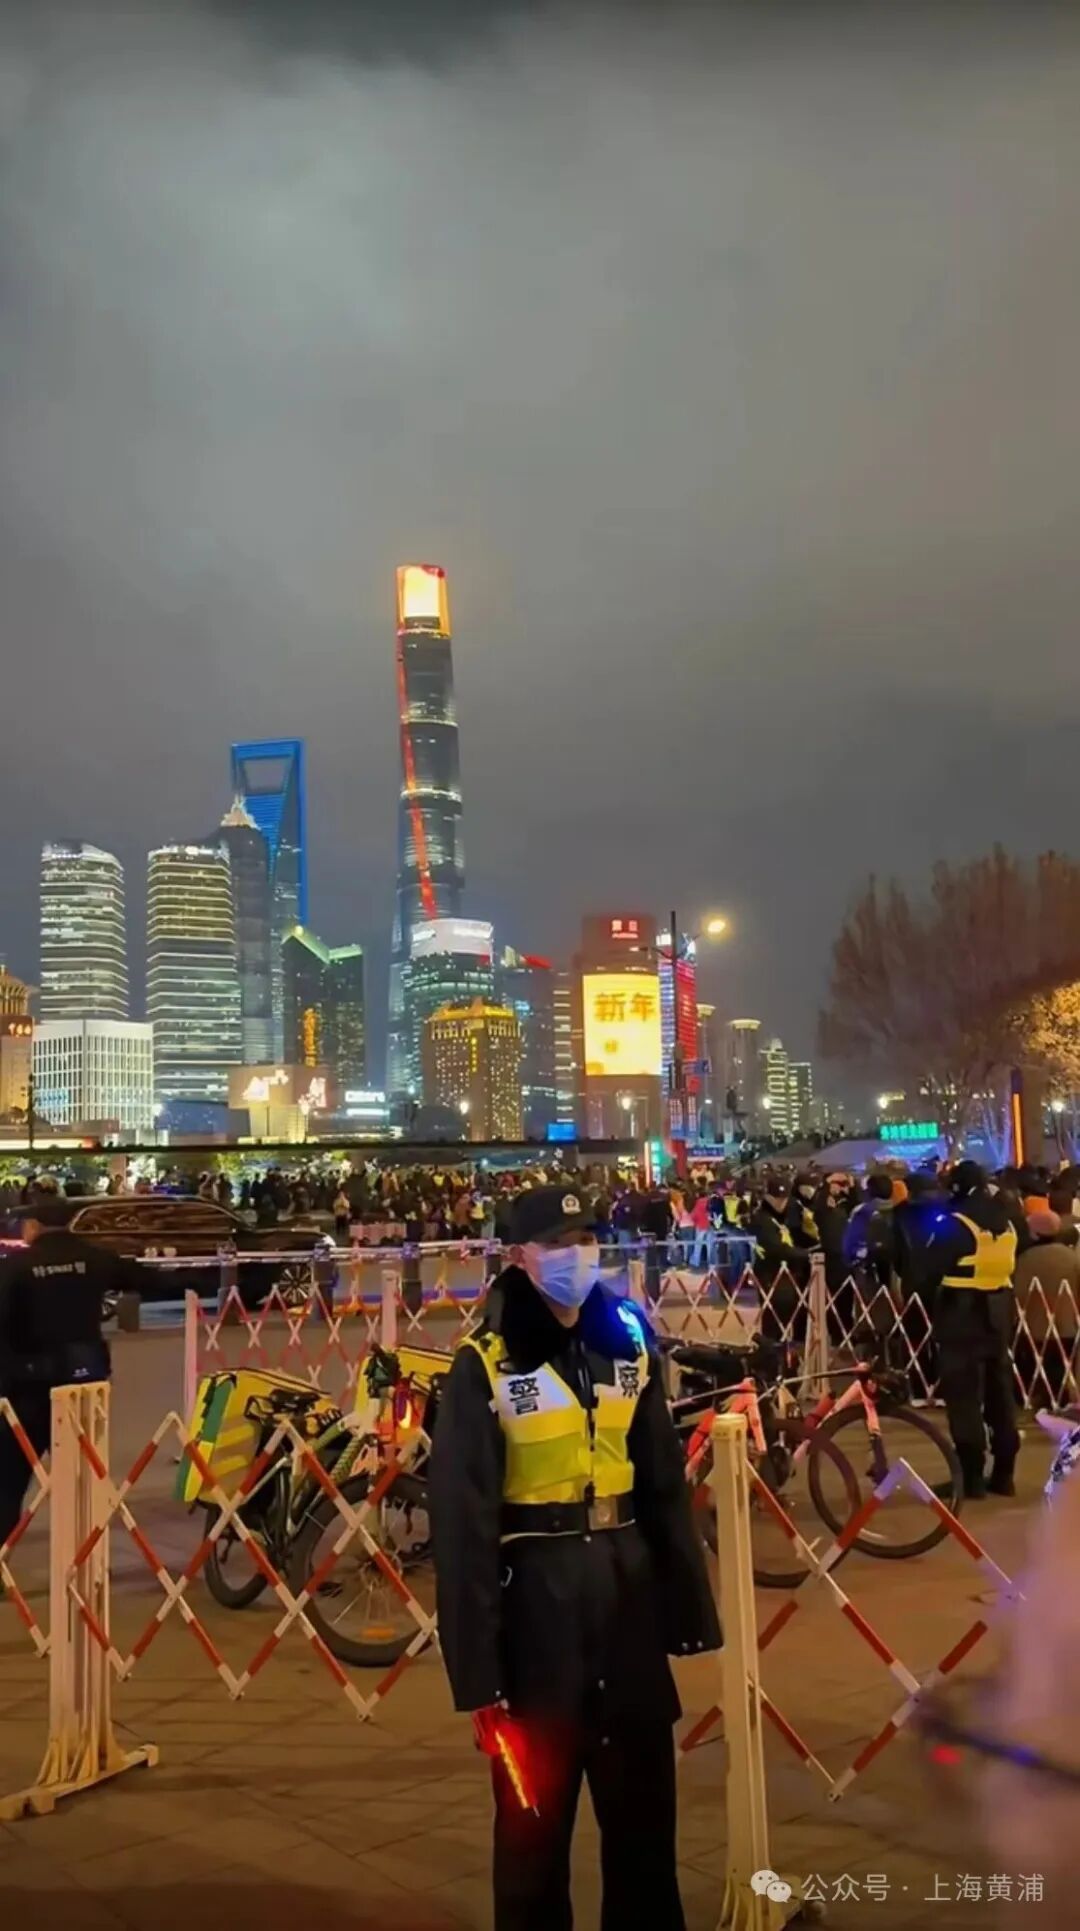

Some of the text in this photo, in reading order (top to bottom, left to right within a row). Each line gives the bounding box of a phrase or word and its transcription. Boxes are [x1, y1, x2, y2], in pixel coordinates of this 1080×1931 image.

[594, 992, 656, 1022] 新年
[508, 1364, 640, 1416] 警 察
